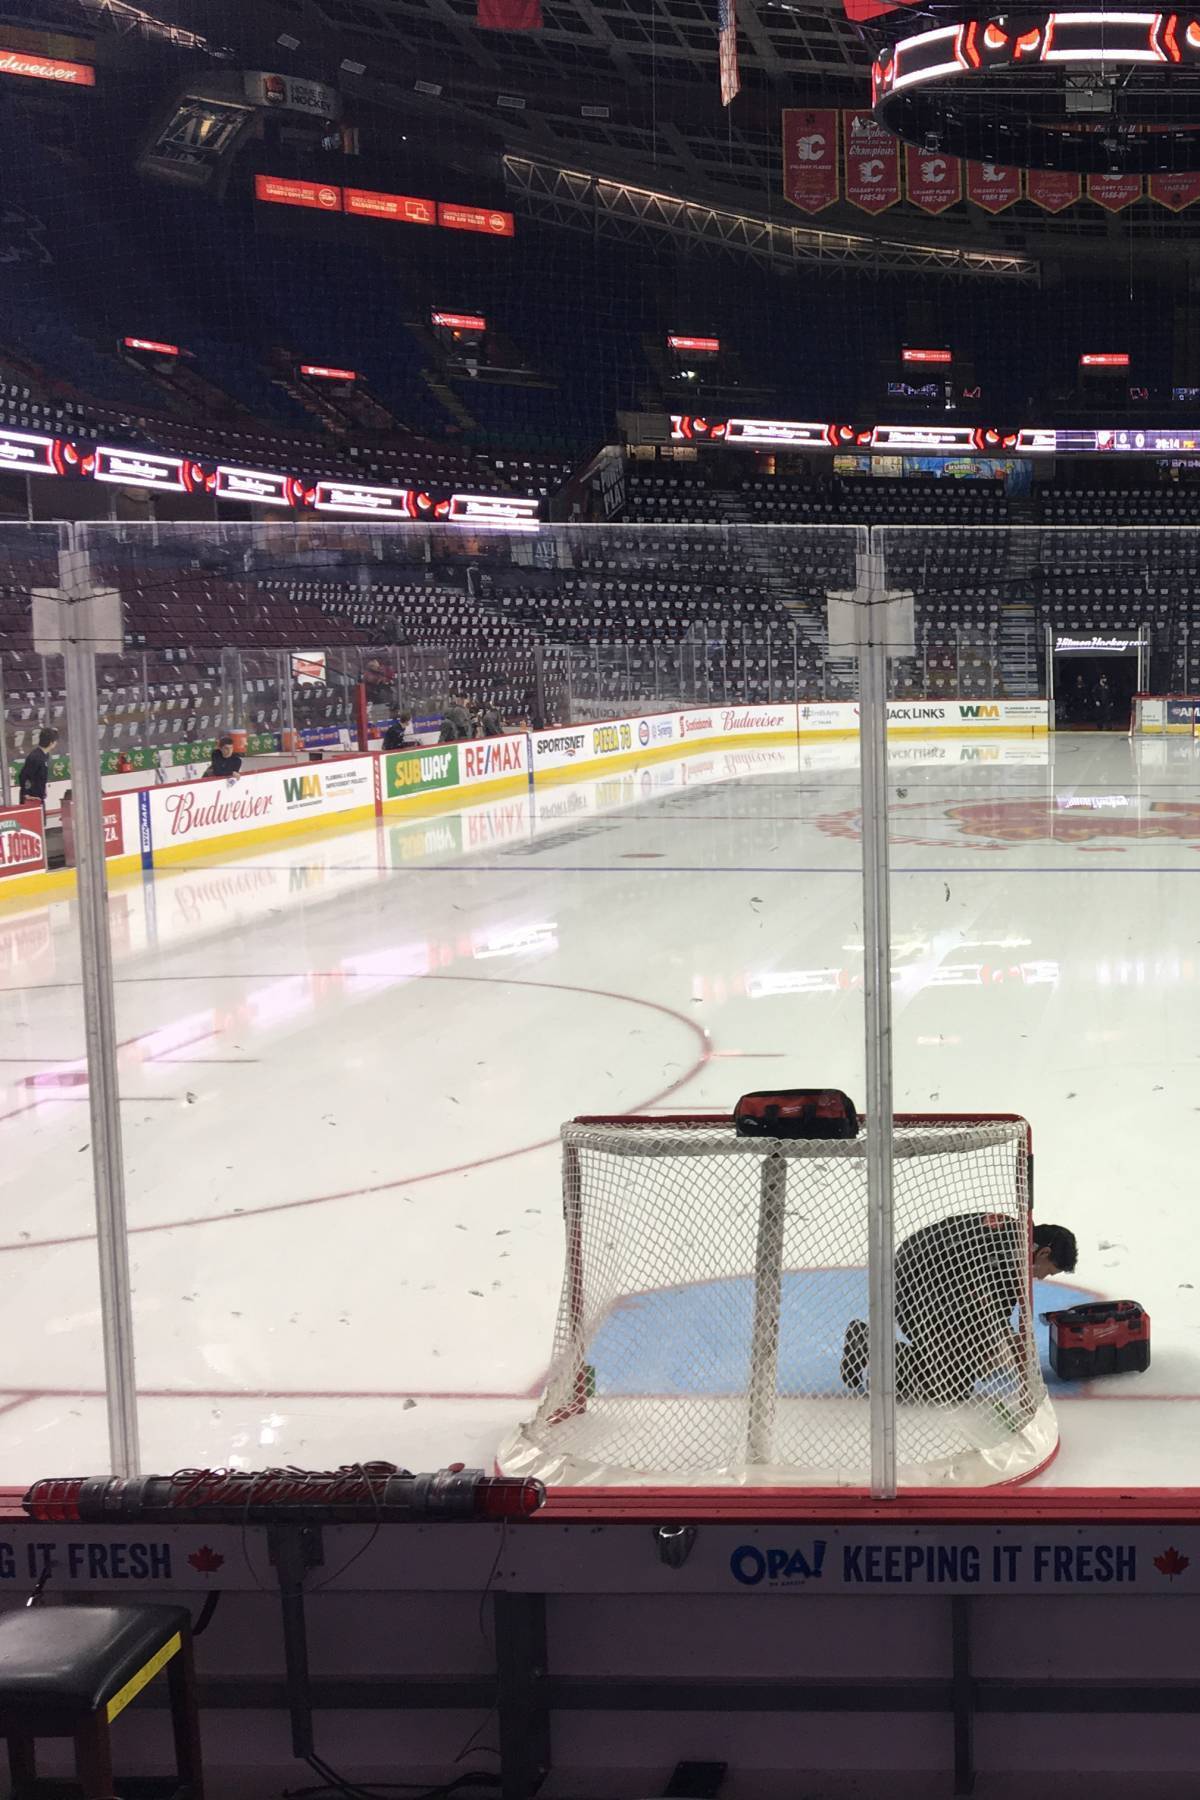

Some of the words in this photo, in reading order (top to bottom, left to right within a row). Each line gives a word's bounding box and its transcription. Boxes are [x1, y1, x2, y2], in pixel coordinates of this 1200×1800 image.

[721, 710, 785, 732] Budweiser
[959, 704, 1000, 718] WM
[536, 734, 586, 756] SPORTSNET
[592, 724, 619, 755] PIZZA
[394, 752, 453, 790] SUBWAY
[465, 742, 523, 778] RE/MAX
[283, 767, 323, 803] WM
[142, 803, 151, 852] WINMAR
[165, 789, 273, 836] Budweiser
[28, 1543, 57, 1579] IT
[68, 1543, 173, 1579] FRESH
[729, 1540, 828, 1586] OPA!
[842, 1544, 982, 1584] KEEPING
[992, 1545, 1023, 1583] IT
[1033, 1545, 1137, 1584] FRESH
